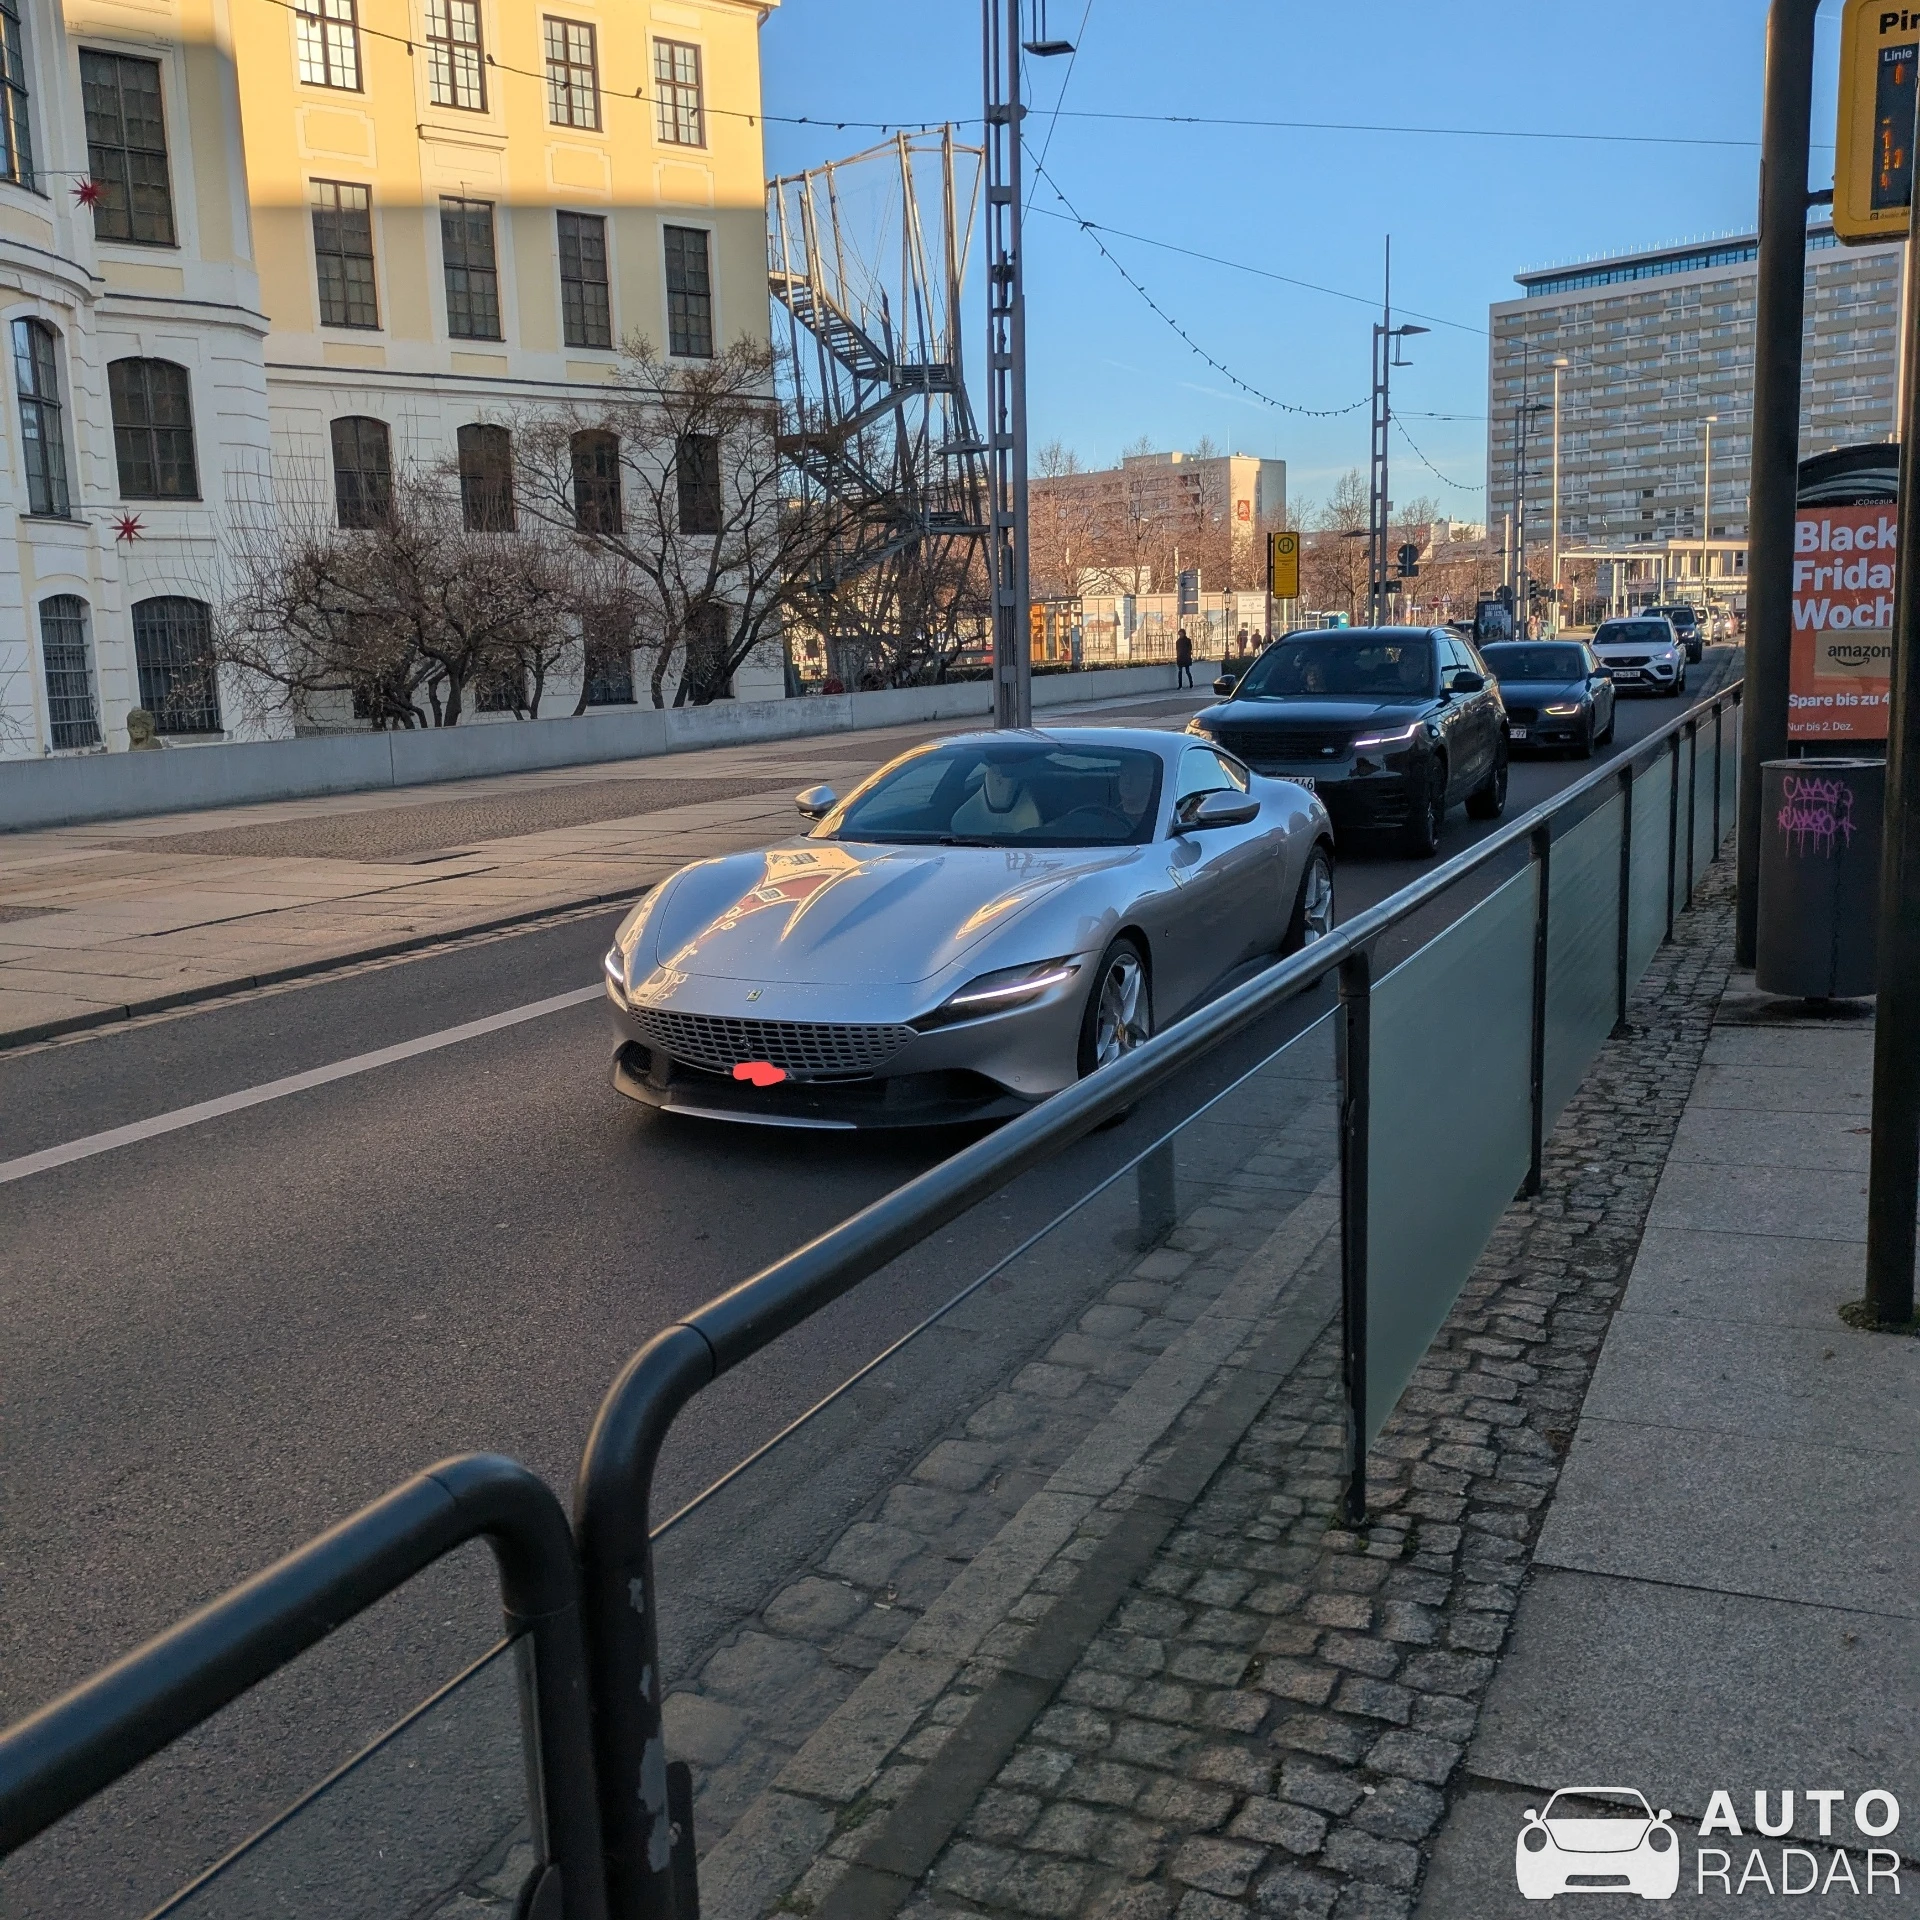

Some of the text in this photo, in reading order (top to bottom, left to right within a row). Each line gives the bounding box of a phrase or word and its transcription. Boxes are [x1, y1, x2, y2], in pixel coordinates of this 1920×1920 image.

[1884, 49, 1912, 62] Linie
[1794, 517, 1897, 553] Black
[1793, 558, 1895, 594] Frida
[1828, 644, 1891, 658] amazon
[1788, 694, 1833, 709] Spare
[1836, 693, 1858, 706] bis
[1861, 695, 1879, 705] zu
[1806, 722, 1820, 731] bis
[1833, 722, 1853, 731] Dez.
